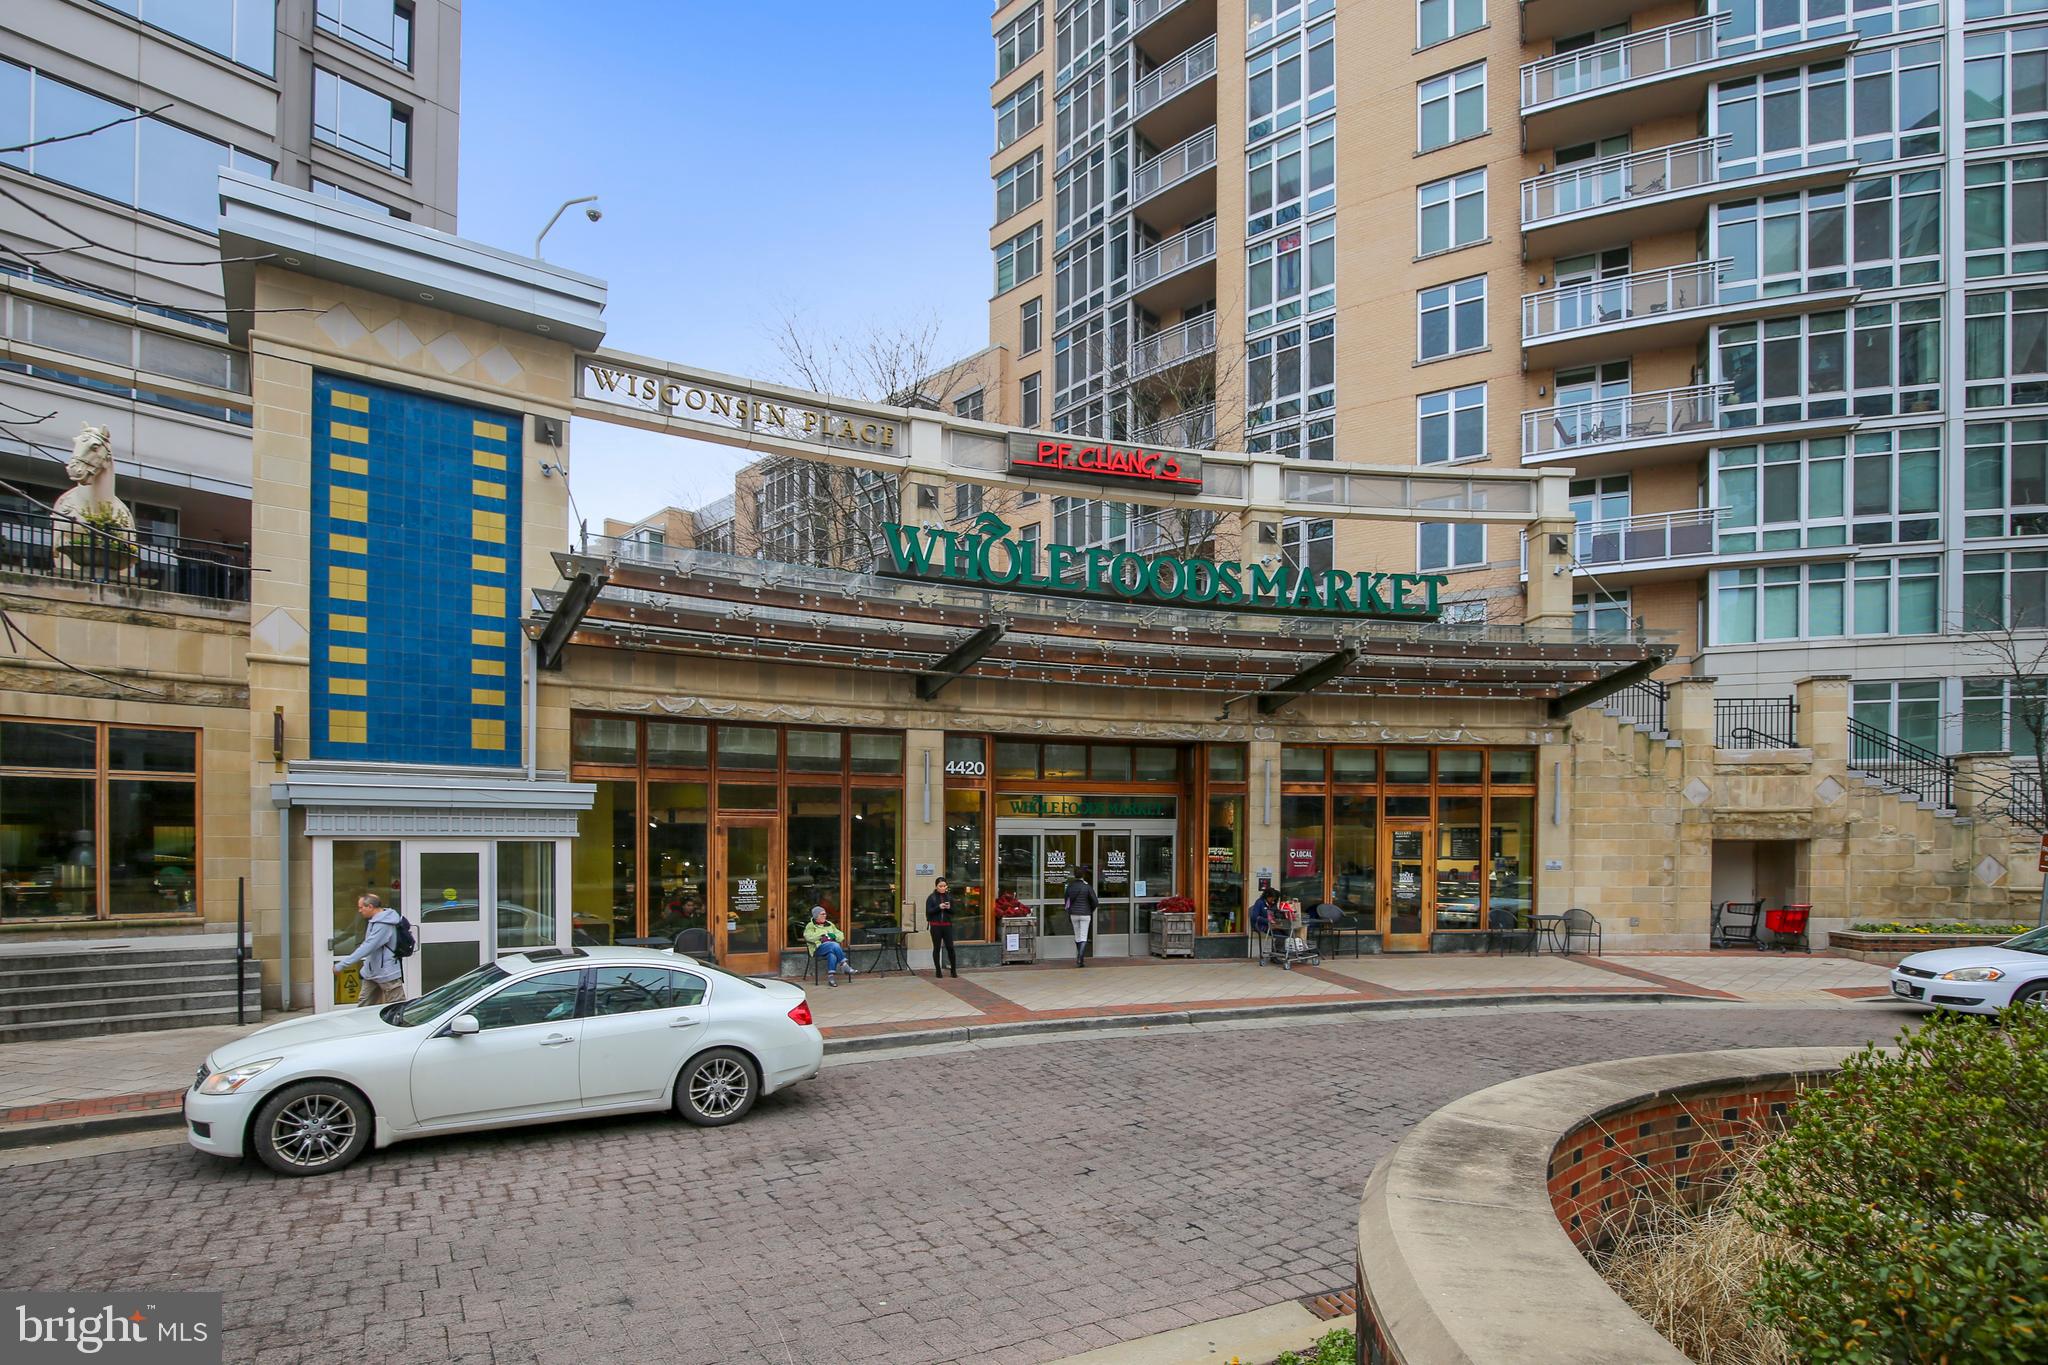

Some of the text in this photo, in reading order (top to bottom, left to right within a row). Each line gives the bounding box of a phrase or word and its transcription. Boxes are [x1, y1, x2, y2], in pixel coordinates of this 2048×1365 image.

[590, 366, 895, 446] WISCONSIN PLACE
[1078, 444, 1182, 479] CHANG'S
[880, 512, 1449, 617] WHOLE FOODS MARKET
[945, 760, 985, 775] 4420
[1010, 796, 1060, 814] WHOLE
[1296, 850, 1312, 858] LOCAL
